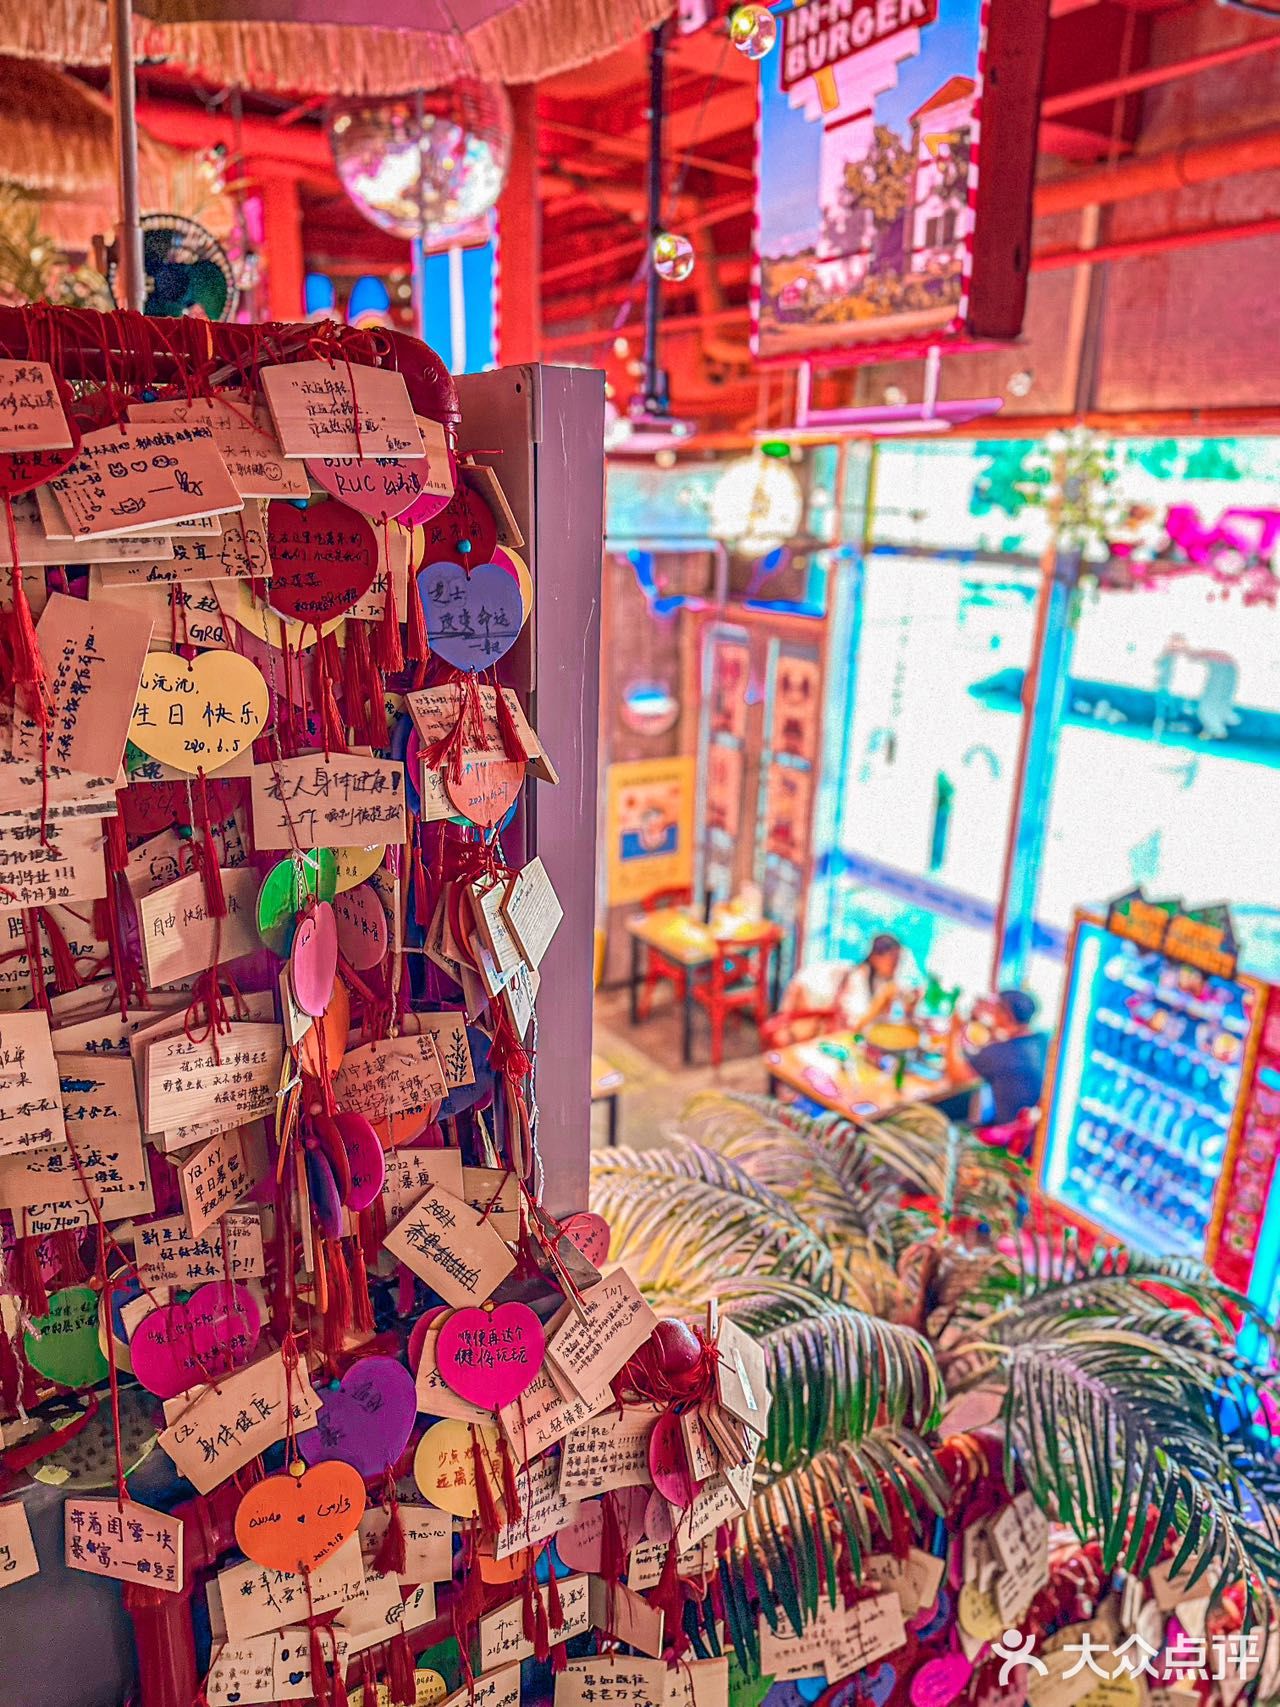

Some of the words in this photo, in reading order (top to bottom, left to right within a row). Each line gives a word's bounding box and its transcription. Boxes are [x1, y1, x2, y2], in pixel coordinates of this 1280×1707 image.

[786, 0, 926, 82] BURGER
[335, 472, 375, 495] RUC
[133, 701, 259, 727] 生日快乐
[196, 1392, 282, 1464] 身体健康
